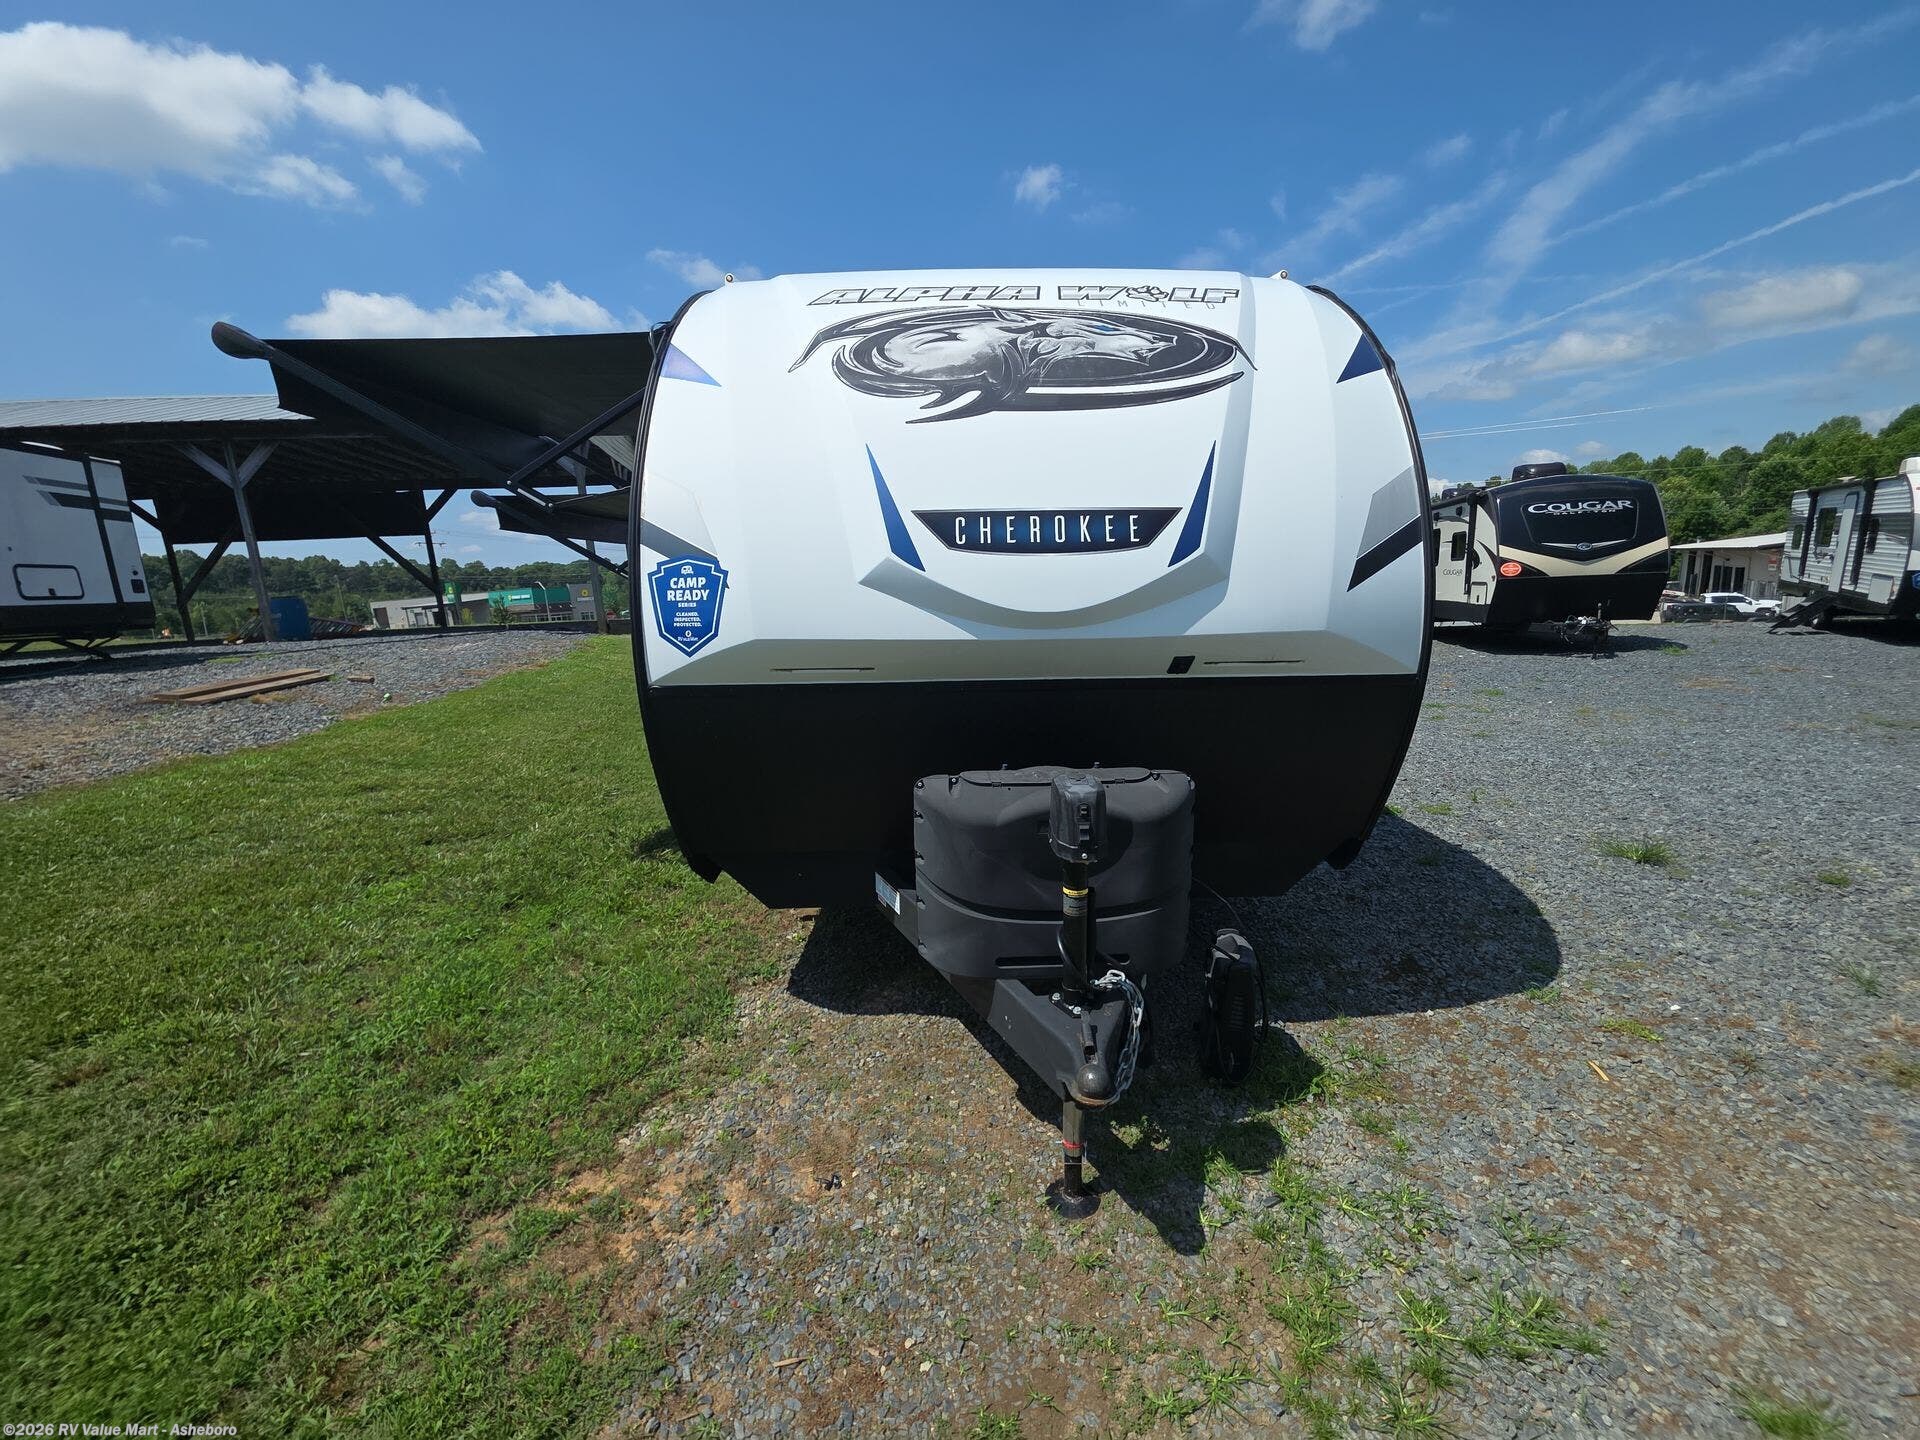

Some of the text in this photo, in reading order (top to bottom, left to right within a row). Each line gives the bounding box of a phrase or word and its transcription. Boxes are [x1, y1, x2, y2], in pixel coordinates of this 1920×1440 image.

[807, 285, 1041, 306] ALPHA
[1528, 500, 1634, 514] COUGAR
[955, 514, 1140, 545] CHEROKEE
[670, 577, 706, 588] CAMP
[667, 590, 710, 600] READY
